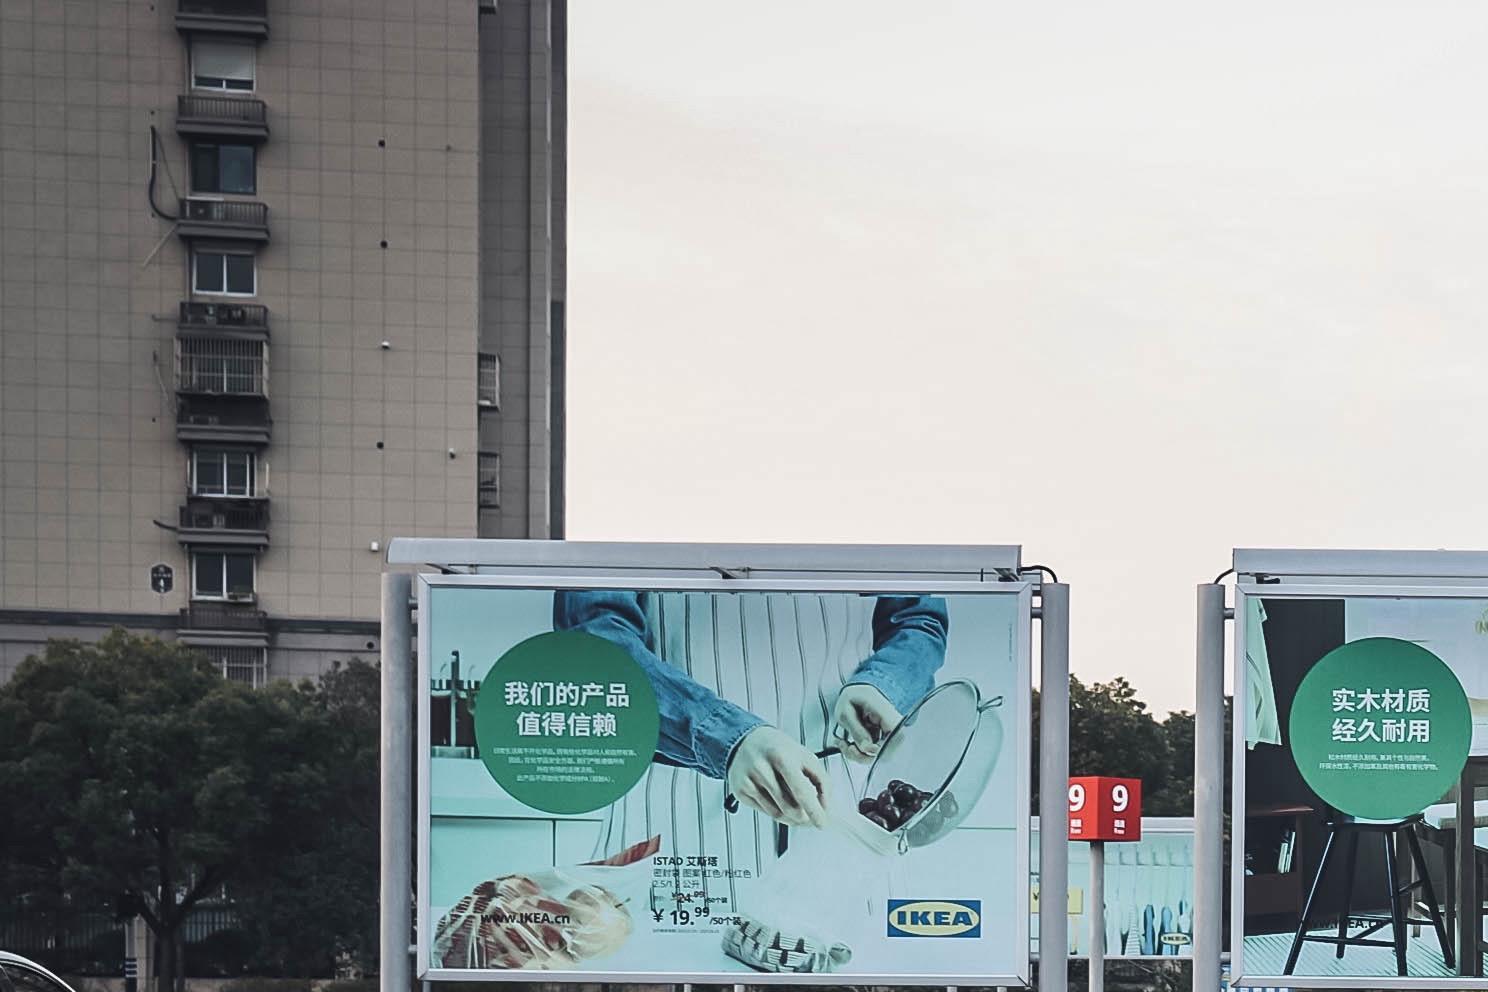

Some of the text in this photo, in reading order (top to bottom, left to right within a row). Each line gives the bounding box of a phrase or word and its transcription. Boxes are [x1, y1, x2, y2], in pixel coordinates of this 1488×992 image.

[504, 681, 630, 708] 我们的产品
[1331, 687, 1431, 713] 实木材质
[516, 711, 617, 737] 值得信赖
[1331, 718, 1431, 743] 经久耐用
[1068, 784, 1085, 812] 9
[1112, 784, 1129, 812] 9
[653, 856, 719, 867] ISTAD 艾斯塔
[480, 912, 570, 925] www.IKEA.cn
[897, 911, 973, 926] IKEA
